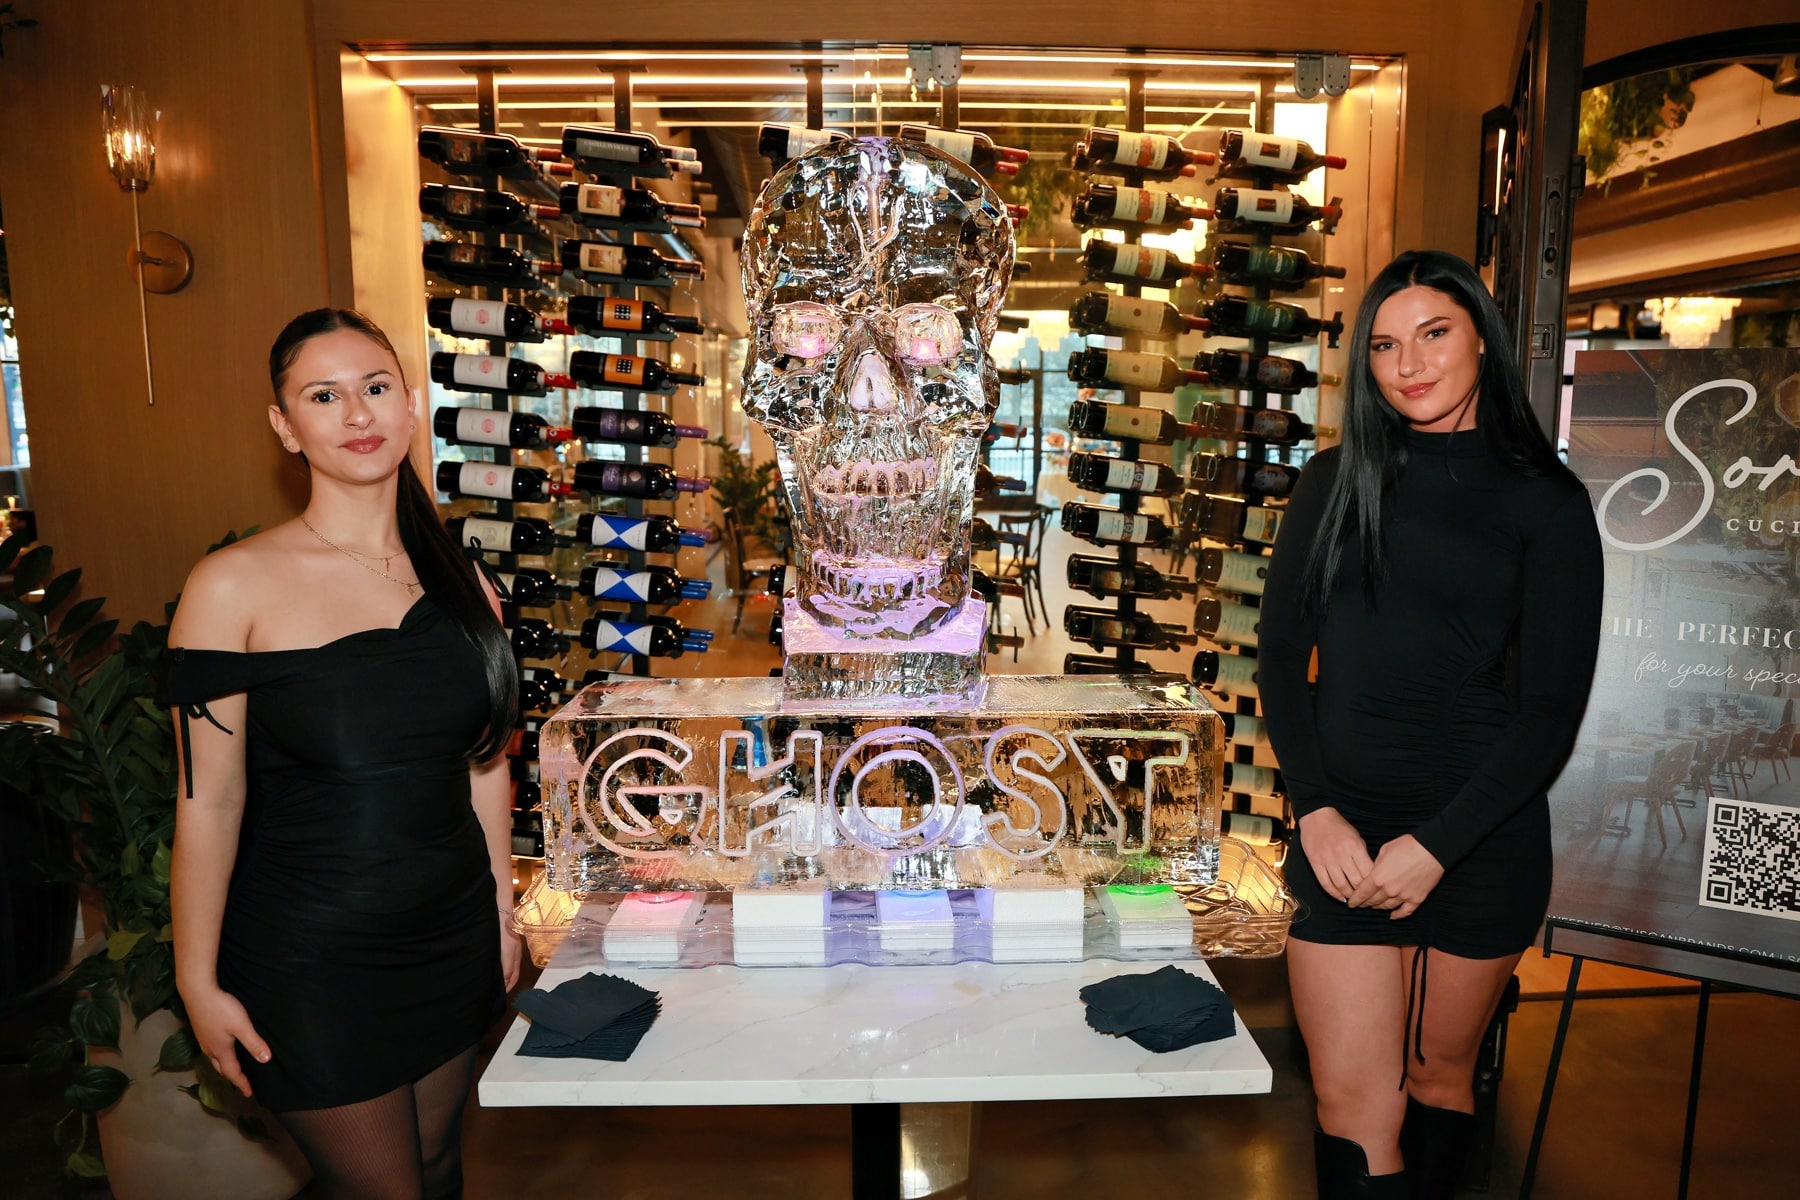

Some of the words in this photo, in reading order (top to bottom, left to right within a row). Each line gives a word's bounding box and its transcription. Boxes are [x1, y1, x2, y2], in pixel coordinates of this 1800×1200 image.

[1606, 615, 1652, 639] HE
[1635, 652, 1669, 682] for
[1667, 662, 1739, 689] your
[1742, 667, 1800, 691] spec
[579, 726, 1190, 858] GHOST
